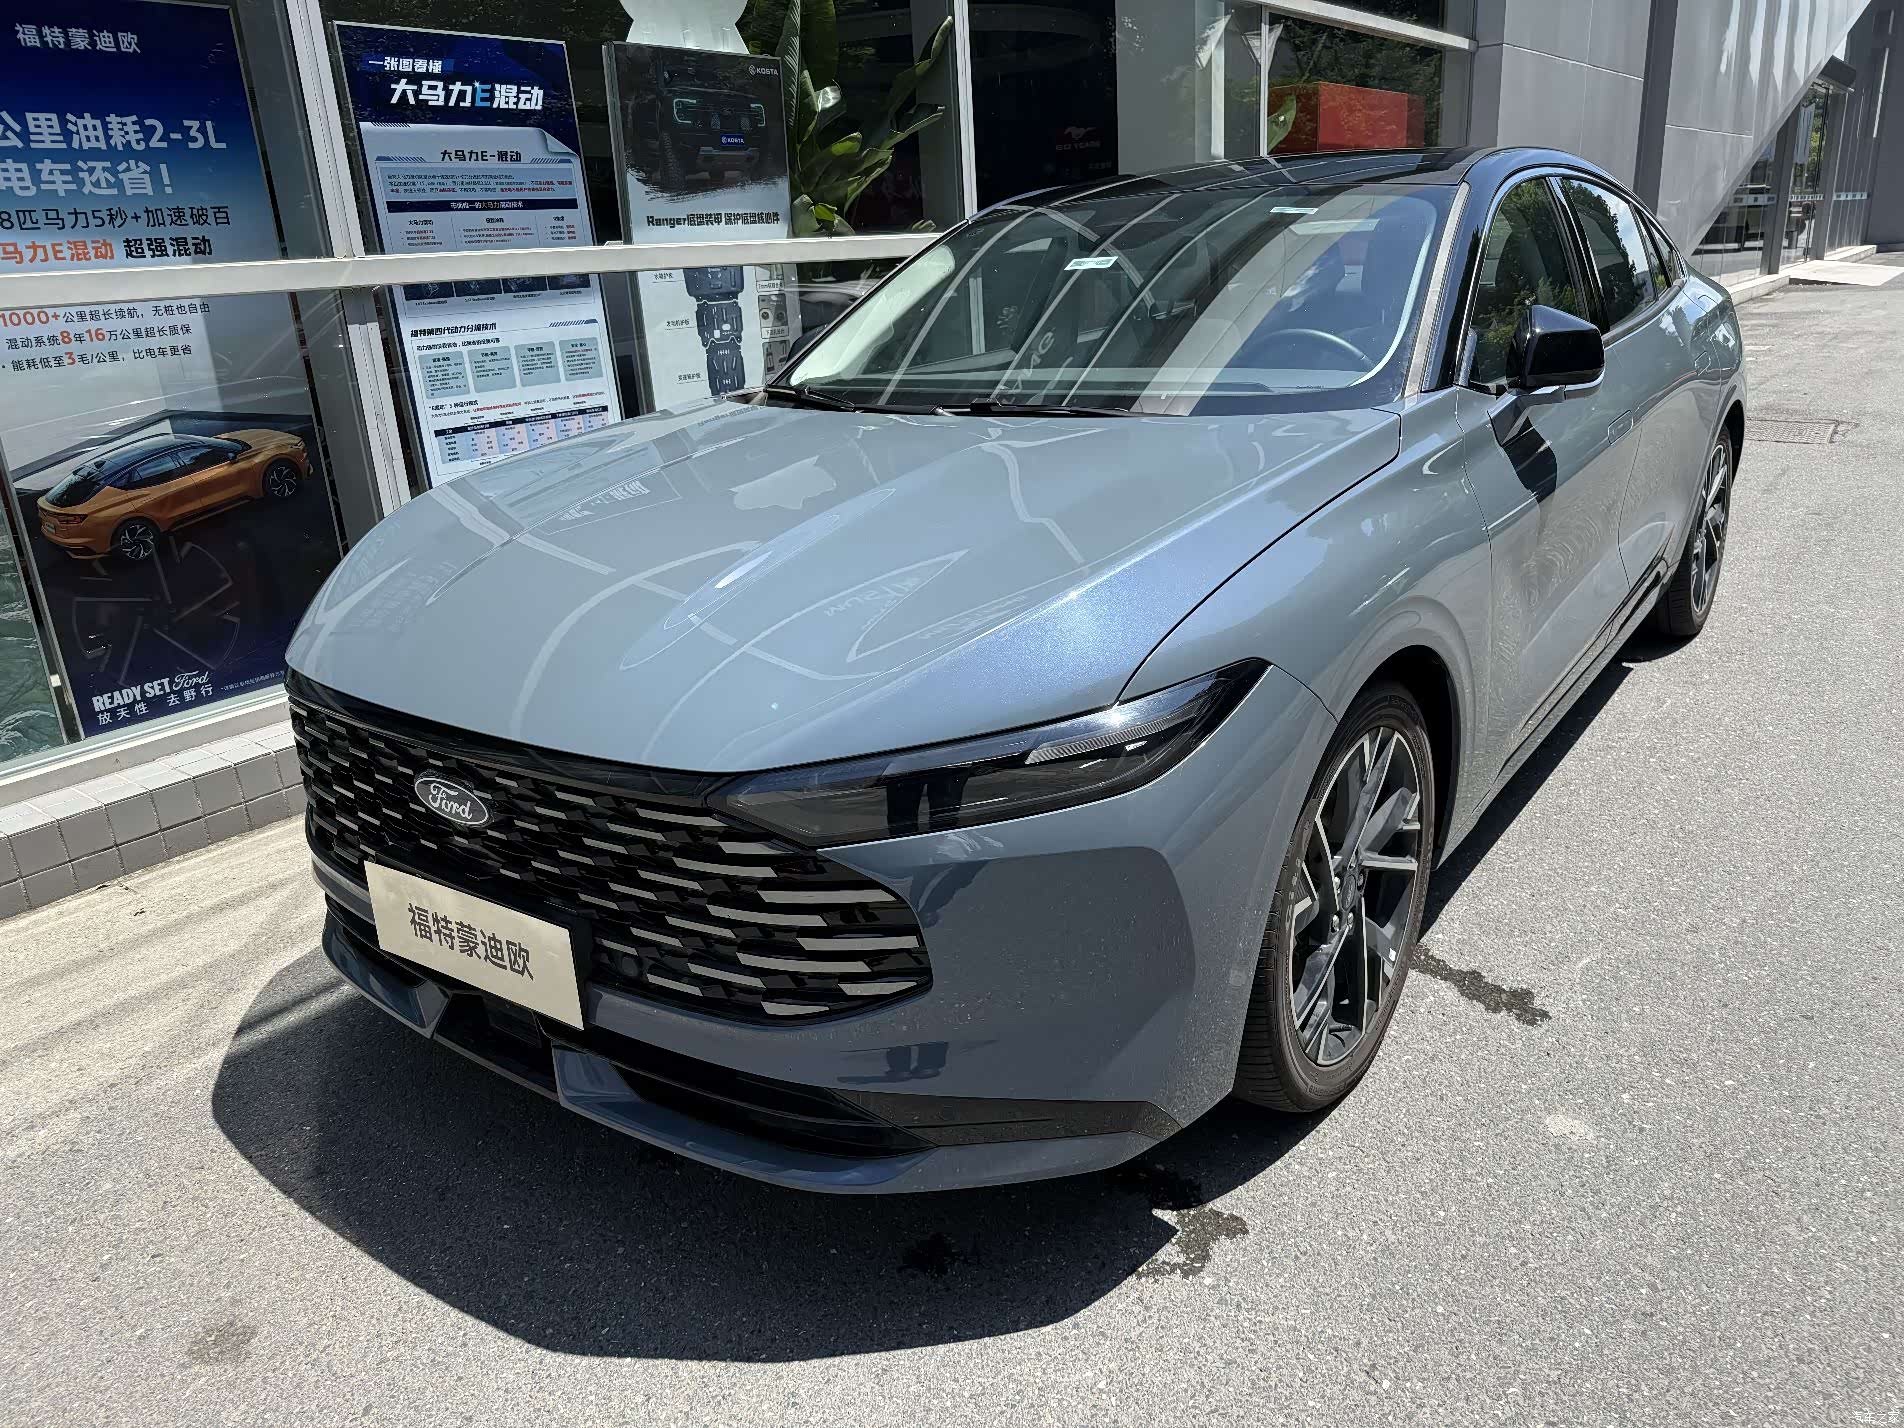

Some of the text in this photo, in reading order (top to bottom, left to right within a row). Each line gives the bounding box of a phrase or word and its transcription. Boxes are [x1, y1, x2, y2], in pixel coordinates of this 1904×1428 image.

[14, 23, 141, 54] 福特蒙迪欧
[368, 56, 443, 74] 一张图看懂
[390, 78, 544, 110] 大马力E混动
[0, 110, 227, 150] 公里油耗2-3L
[440, 150, 522, 163] 大马力E-混动
[0, 205, 231, 230] 8匹马力5秒+加速破百
[0, 235, 213, 265] 马力E混动 超强混动
[5, 323, 193, 351] 混动系统8年16万公里超长质保
[92, 685, 144, 711] READY
[144, 677, 171, 698] SET
[172, 671, 209, 691] Ford
[97, 684, 213, 725] 放天性 去野行
[428, 782, 473, 820] Ford
[408, 903, 534, 981] 福特蒙迪欧
